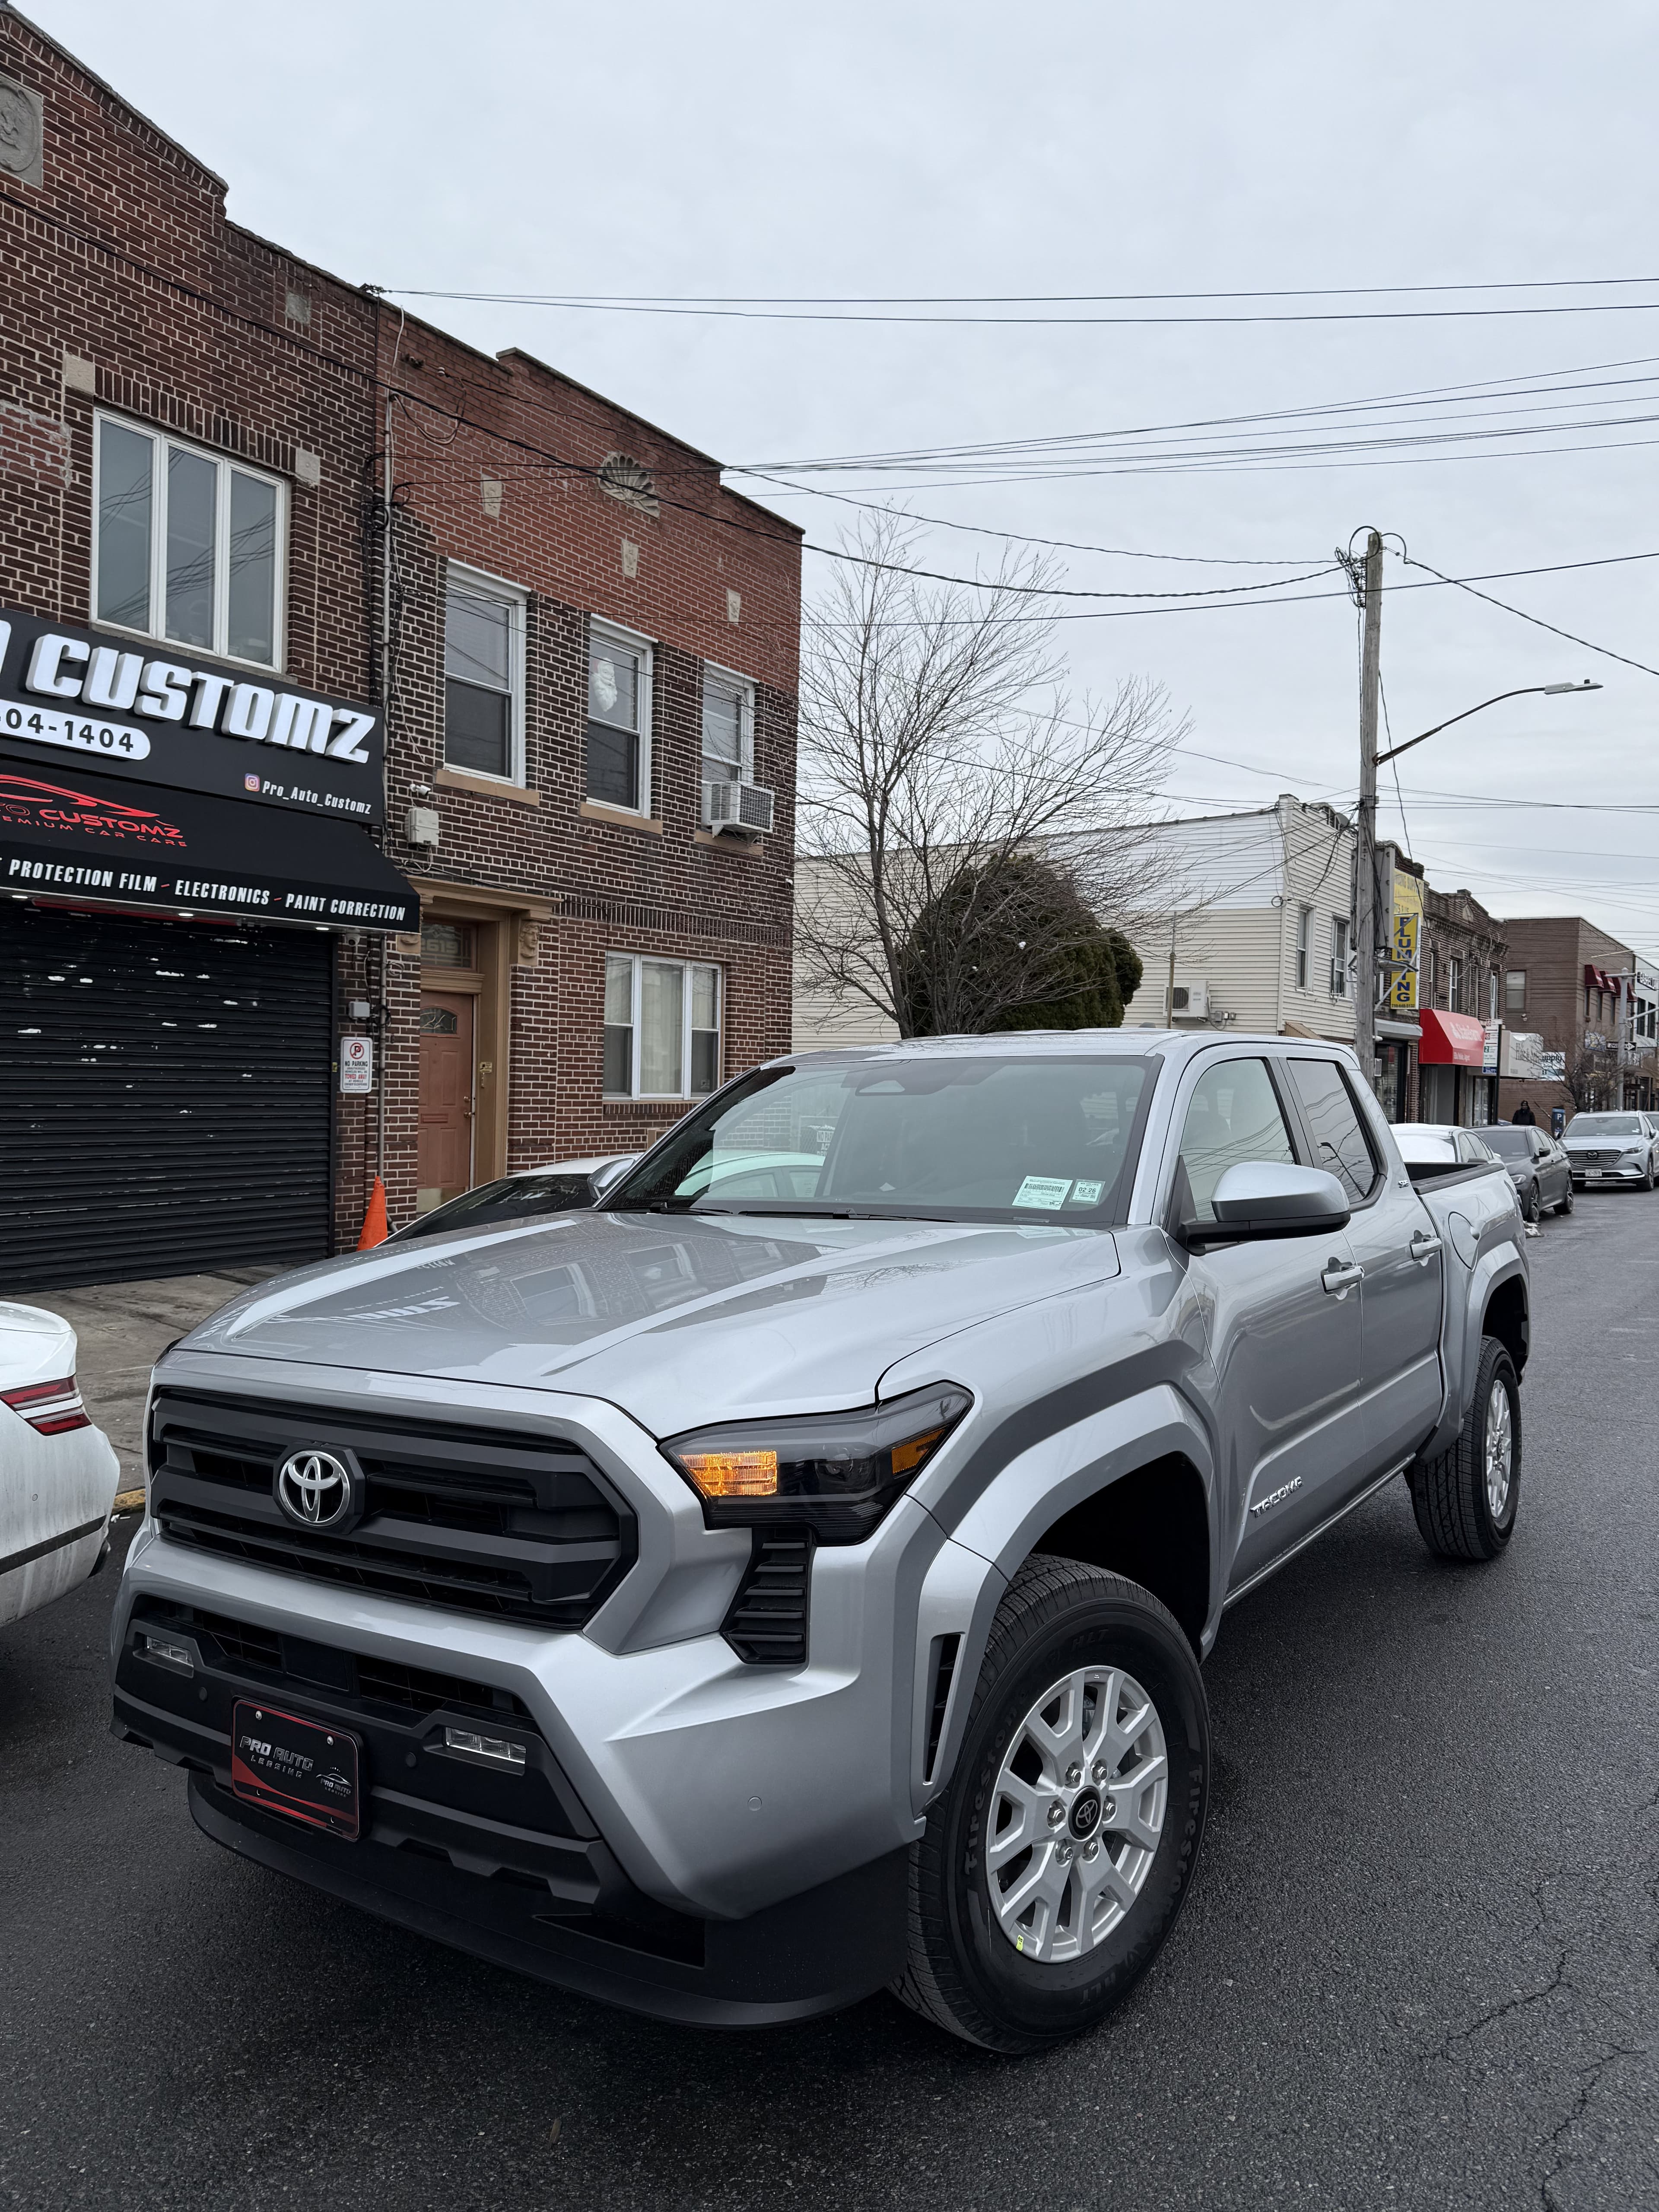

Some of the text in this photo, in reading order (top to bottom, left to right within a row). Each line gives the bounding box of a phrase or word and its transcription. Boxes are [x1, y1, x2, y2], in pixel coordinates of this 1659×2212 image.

[25, 633, 375, 764] CUSTOMZ
[0, 708, 133, 752] 04-1404
[262, 781, 371, 814] Pro_Auto_Customz
[39, 809, 183, 838] CUSTOMZ
[85, 828, 126, 838] CAR
[137, 836, 188, 847] CARE
[9, 859, 406, 921] PROTECTION FILM ELECTRONICS PAINT CORRECTION
[1396, 917, 1411, 1002] PLUMING
[240, 1736, 314, 1772] PRO AUTO
[251, 1755, 303, 1779] LEASING
[321, 1778, 334, 1788] PRO
